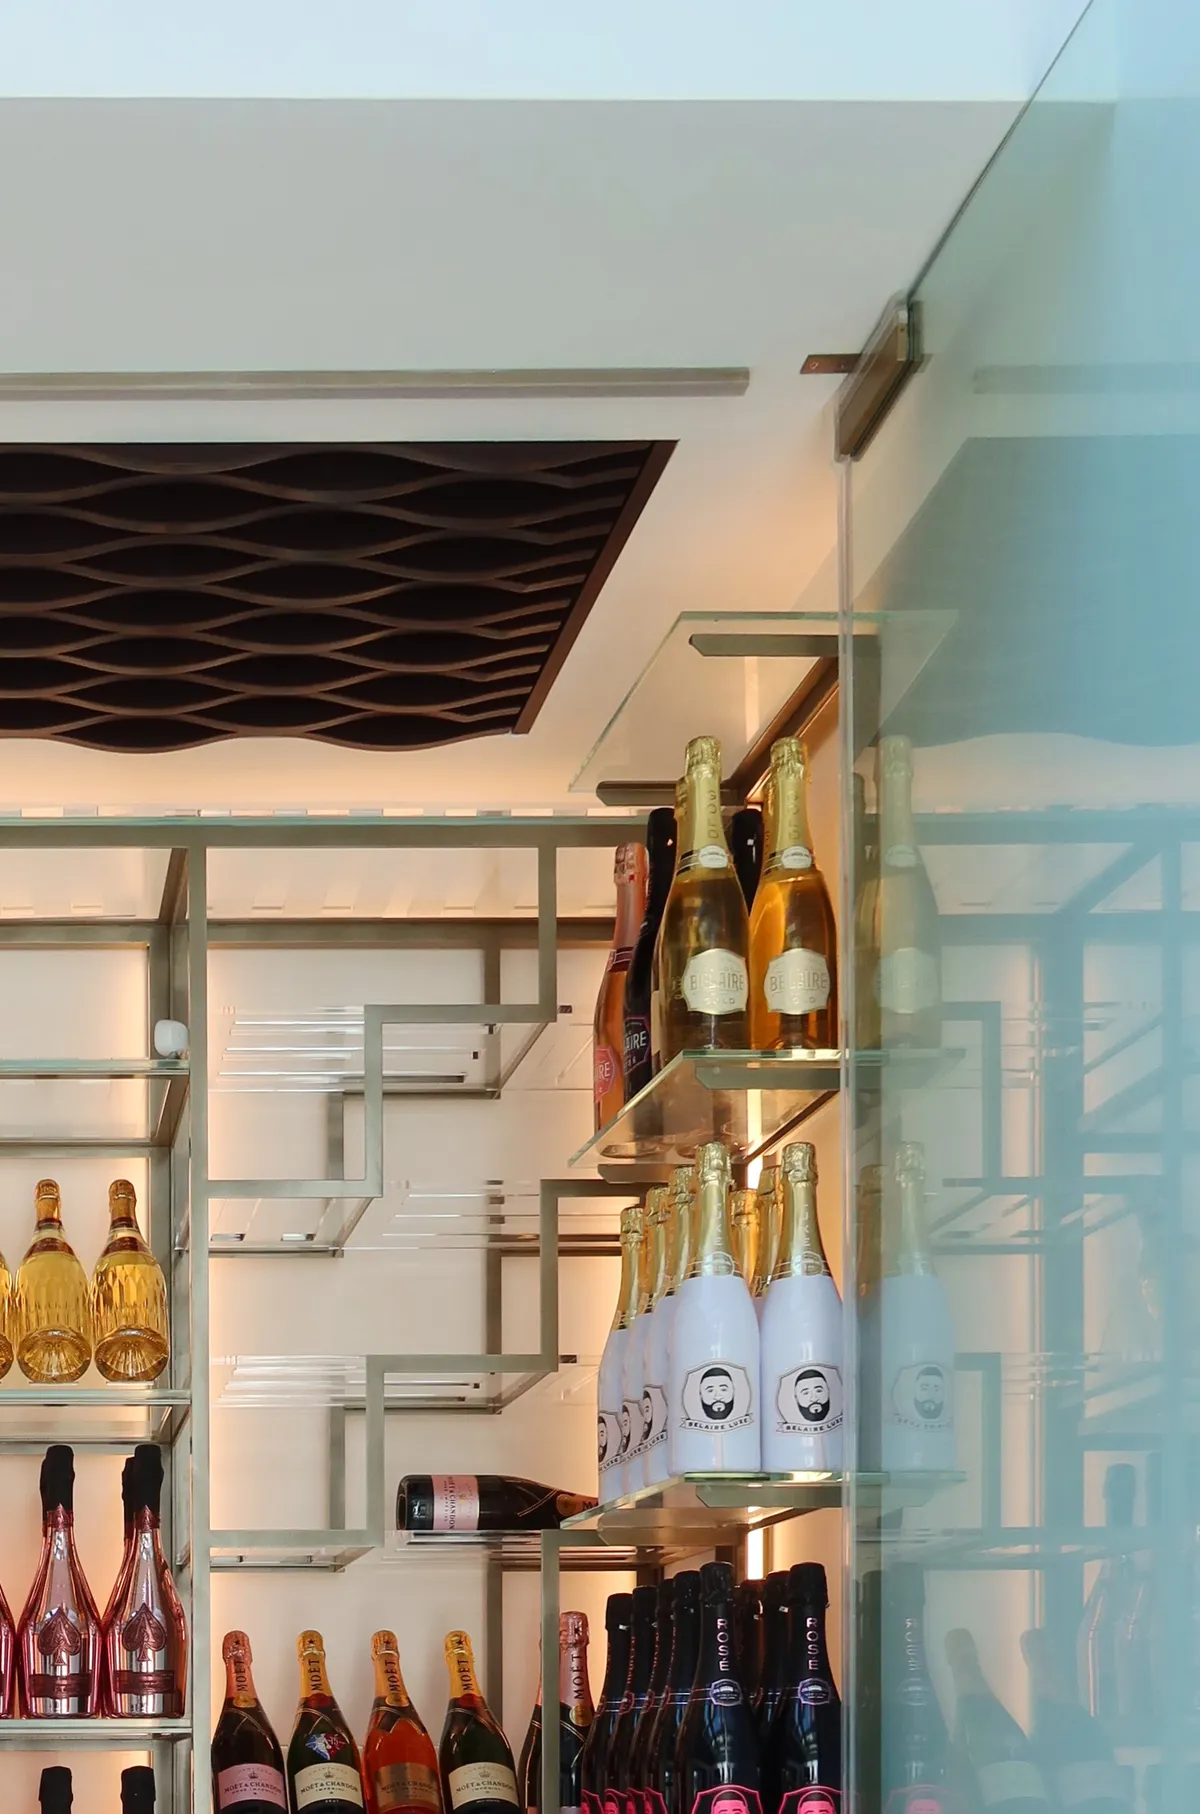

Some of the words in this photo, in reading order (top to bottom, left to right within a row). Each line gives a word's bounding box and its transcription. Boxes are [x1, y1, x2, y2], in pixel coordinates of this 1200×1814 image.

[707, 789, 720, 840] GOLD
[688, 1420, 726, 1431] BELAIRE
[729, 1417, 749, 1429] LUXE
[786, 1422, 825, 1433] BELAIRE
